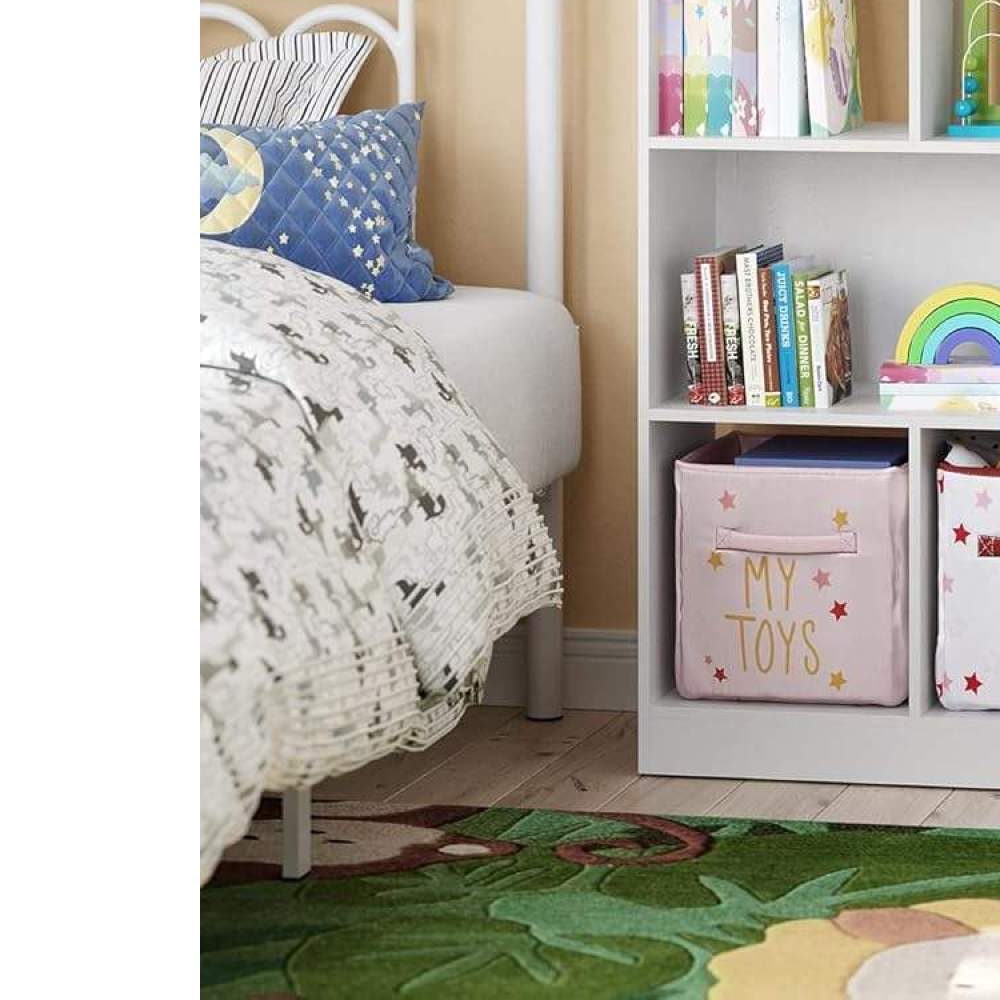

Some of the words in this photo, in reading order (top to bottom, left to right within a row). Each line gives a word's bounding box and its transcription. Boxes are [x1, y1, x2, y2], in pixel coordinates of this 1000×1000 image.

[777, 271, 787, 303] JUICY
[795, 281, 804, 317] SALAD
[686, 323, 698, 358] FRESH
[725, 322, 737, 359] FRESH
[780, 305, 791, 347] DRINKS
[799, 335, 810, 378] DINNER
[744, 555, 797, 611] MY
[724, 614, 820, 675] TOYS
